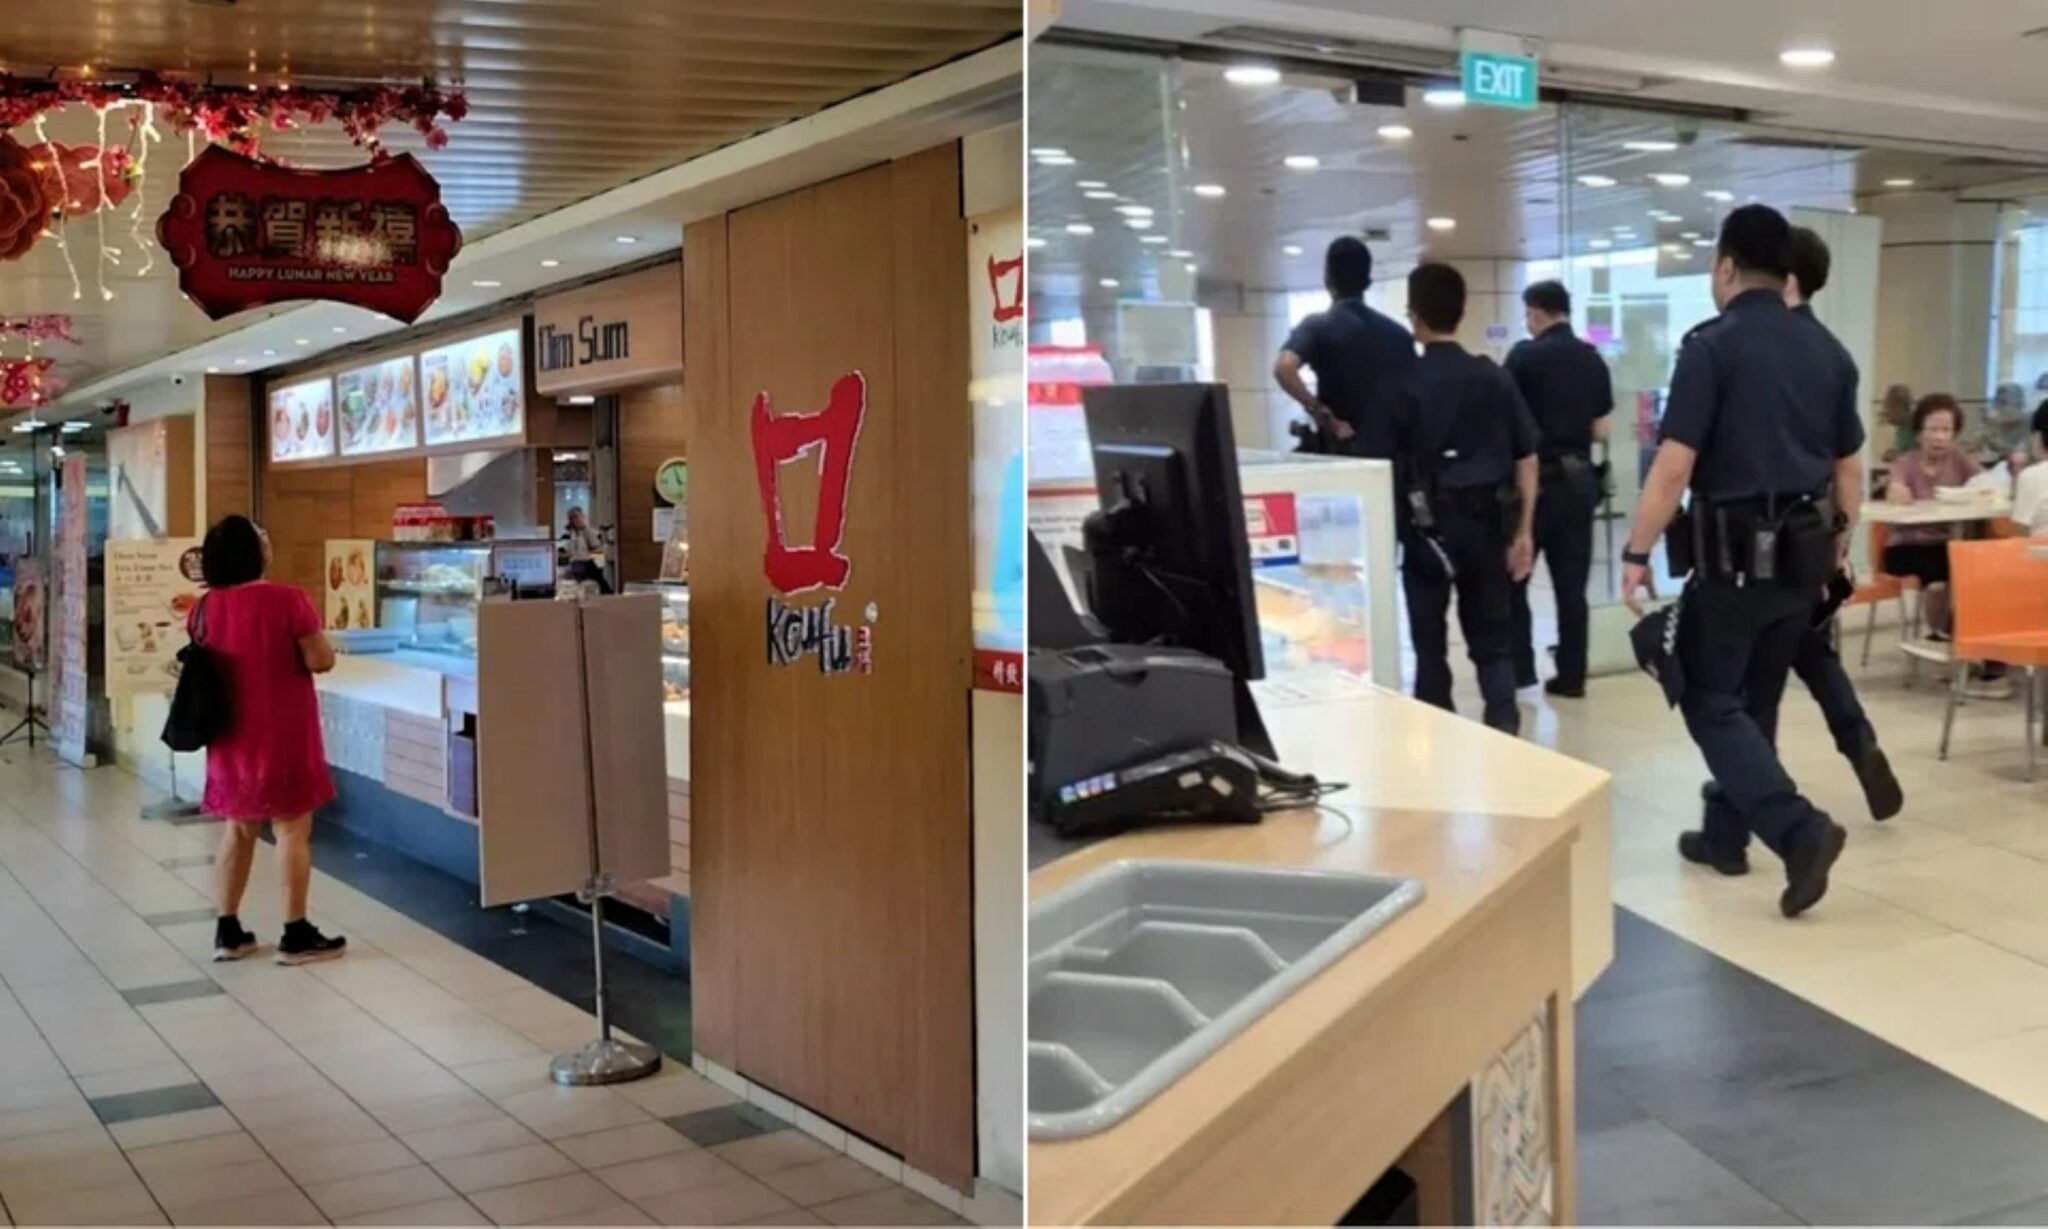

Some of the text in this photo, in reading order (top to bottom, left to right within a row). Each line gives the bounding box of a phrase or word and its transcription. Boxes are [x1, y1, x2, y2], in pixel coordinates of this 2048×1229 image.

[1475, 60, 1526, 98] EXIT
[229, 265, 395, 285] HAPPY LUNAR NEW YEAR
[538, 315, 630, 373] Dim Sum
